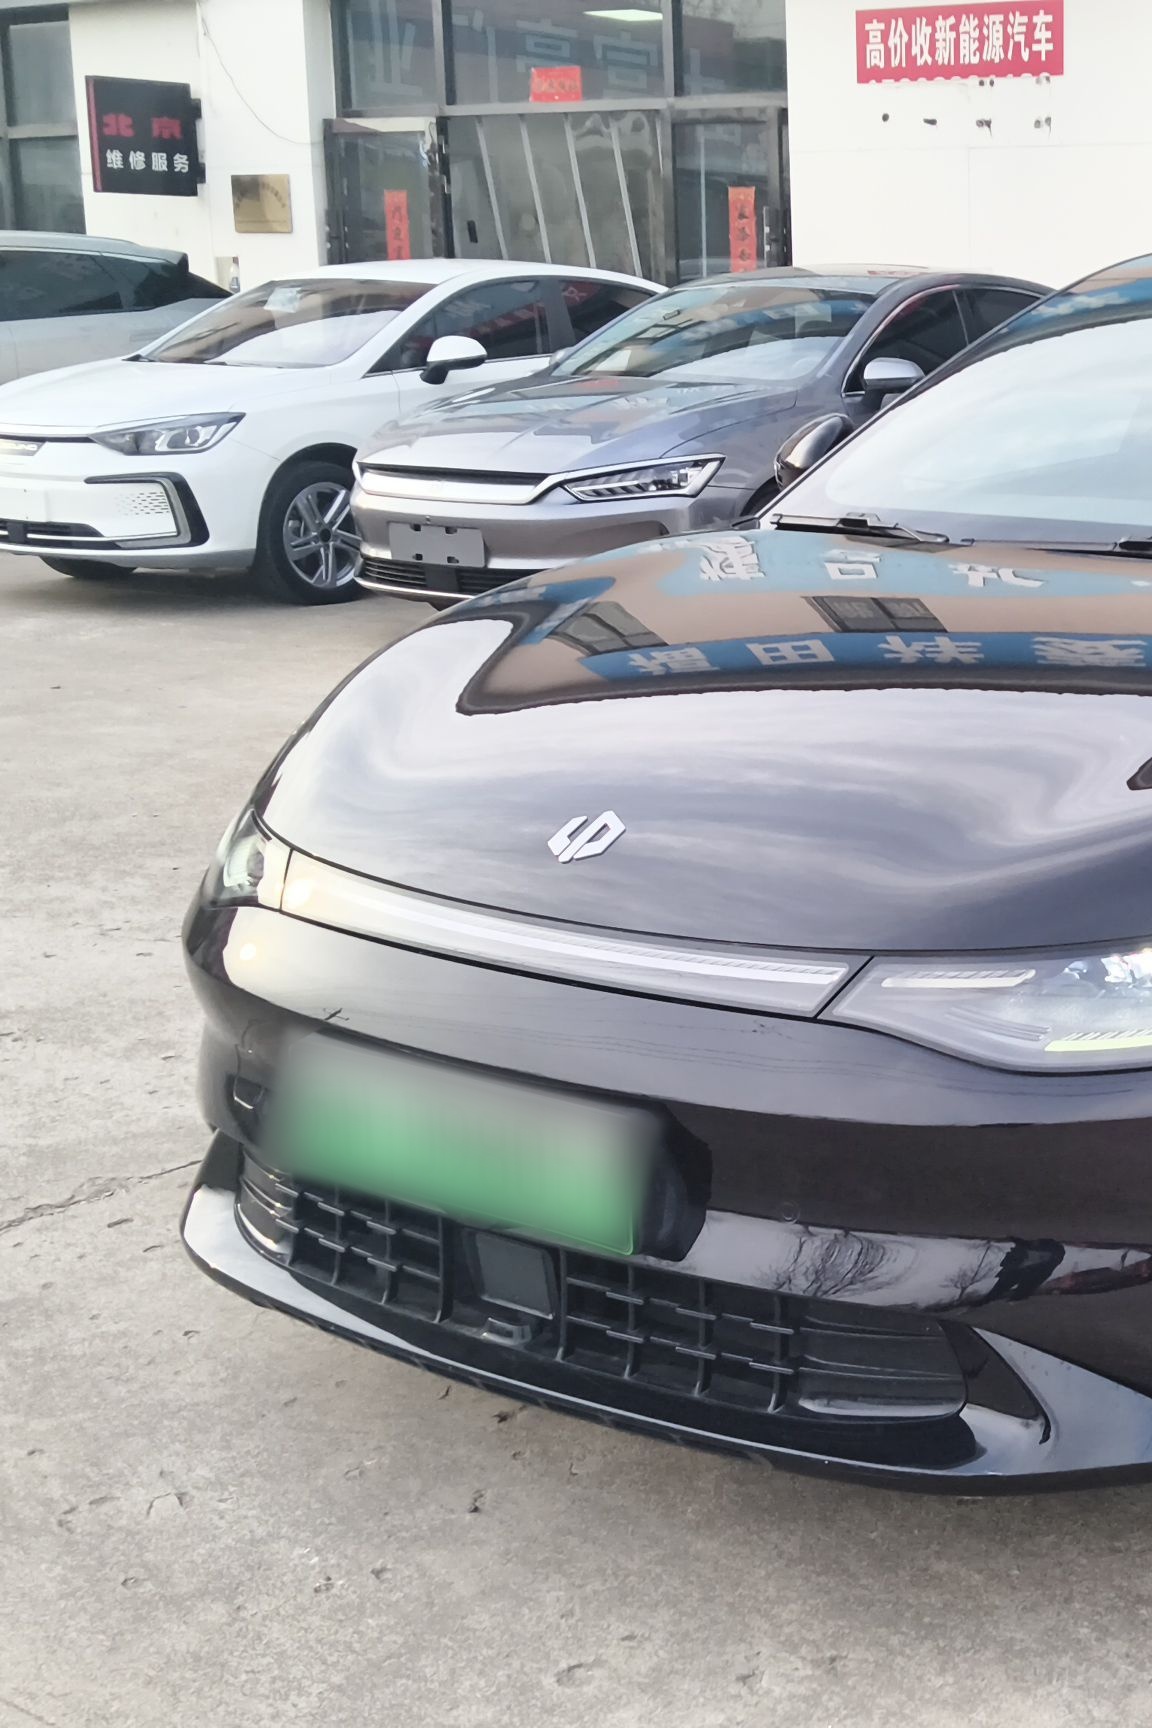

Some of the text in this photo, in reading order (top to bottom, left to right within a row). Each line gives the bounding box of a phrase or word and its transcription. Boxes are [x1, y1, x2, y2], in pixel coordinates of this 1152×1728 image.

[865, 9, 1054, 69] 高价收新能源汽车
[102, 113, 183, 139] 北京
[105, 149, 190, 173] 维修服务
